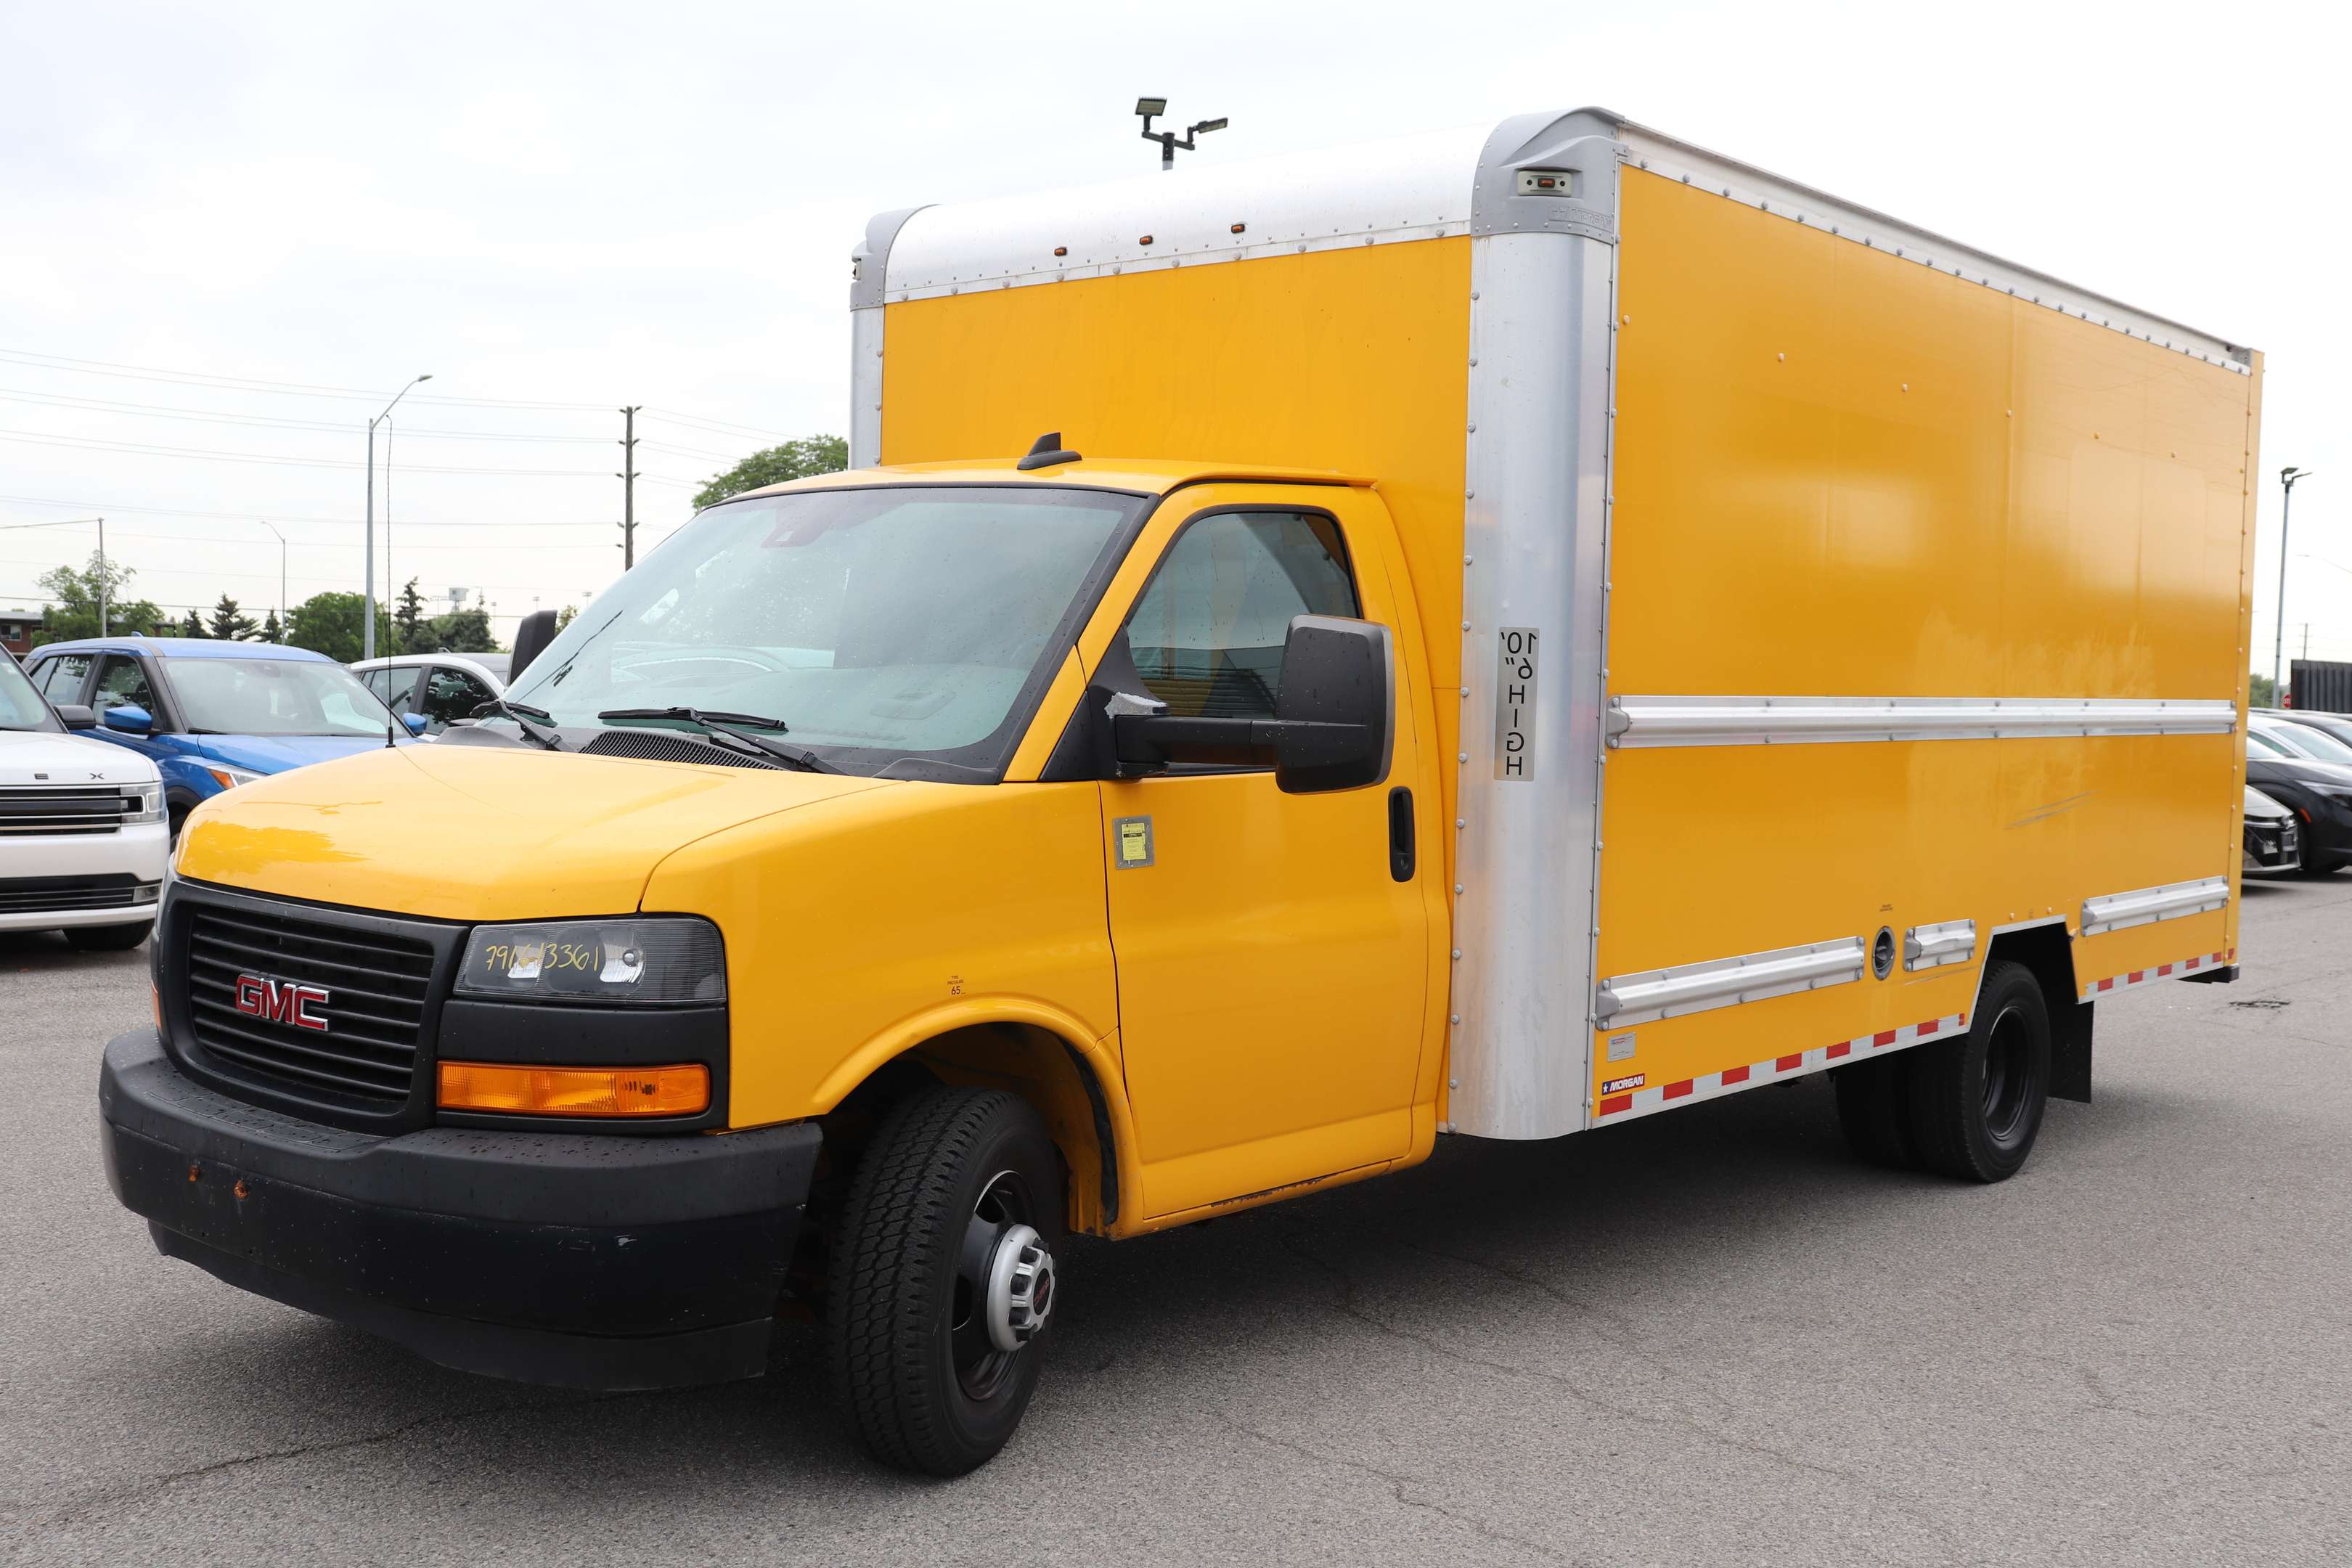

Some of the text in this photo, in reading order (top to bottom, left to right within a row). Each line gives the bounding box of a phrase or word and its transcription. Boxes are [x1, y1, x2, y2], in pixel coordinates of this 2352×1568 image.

[951, 986, 960, 995] 65
[234, 973, 330, 1032] GMC
[1609, 1075, 1644, 1092] MORGAN
